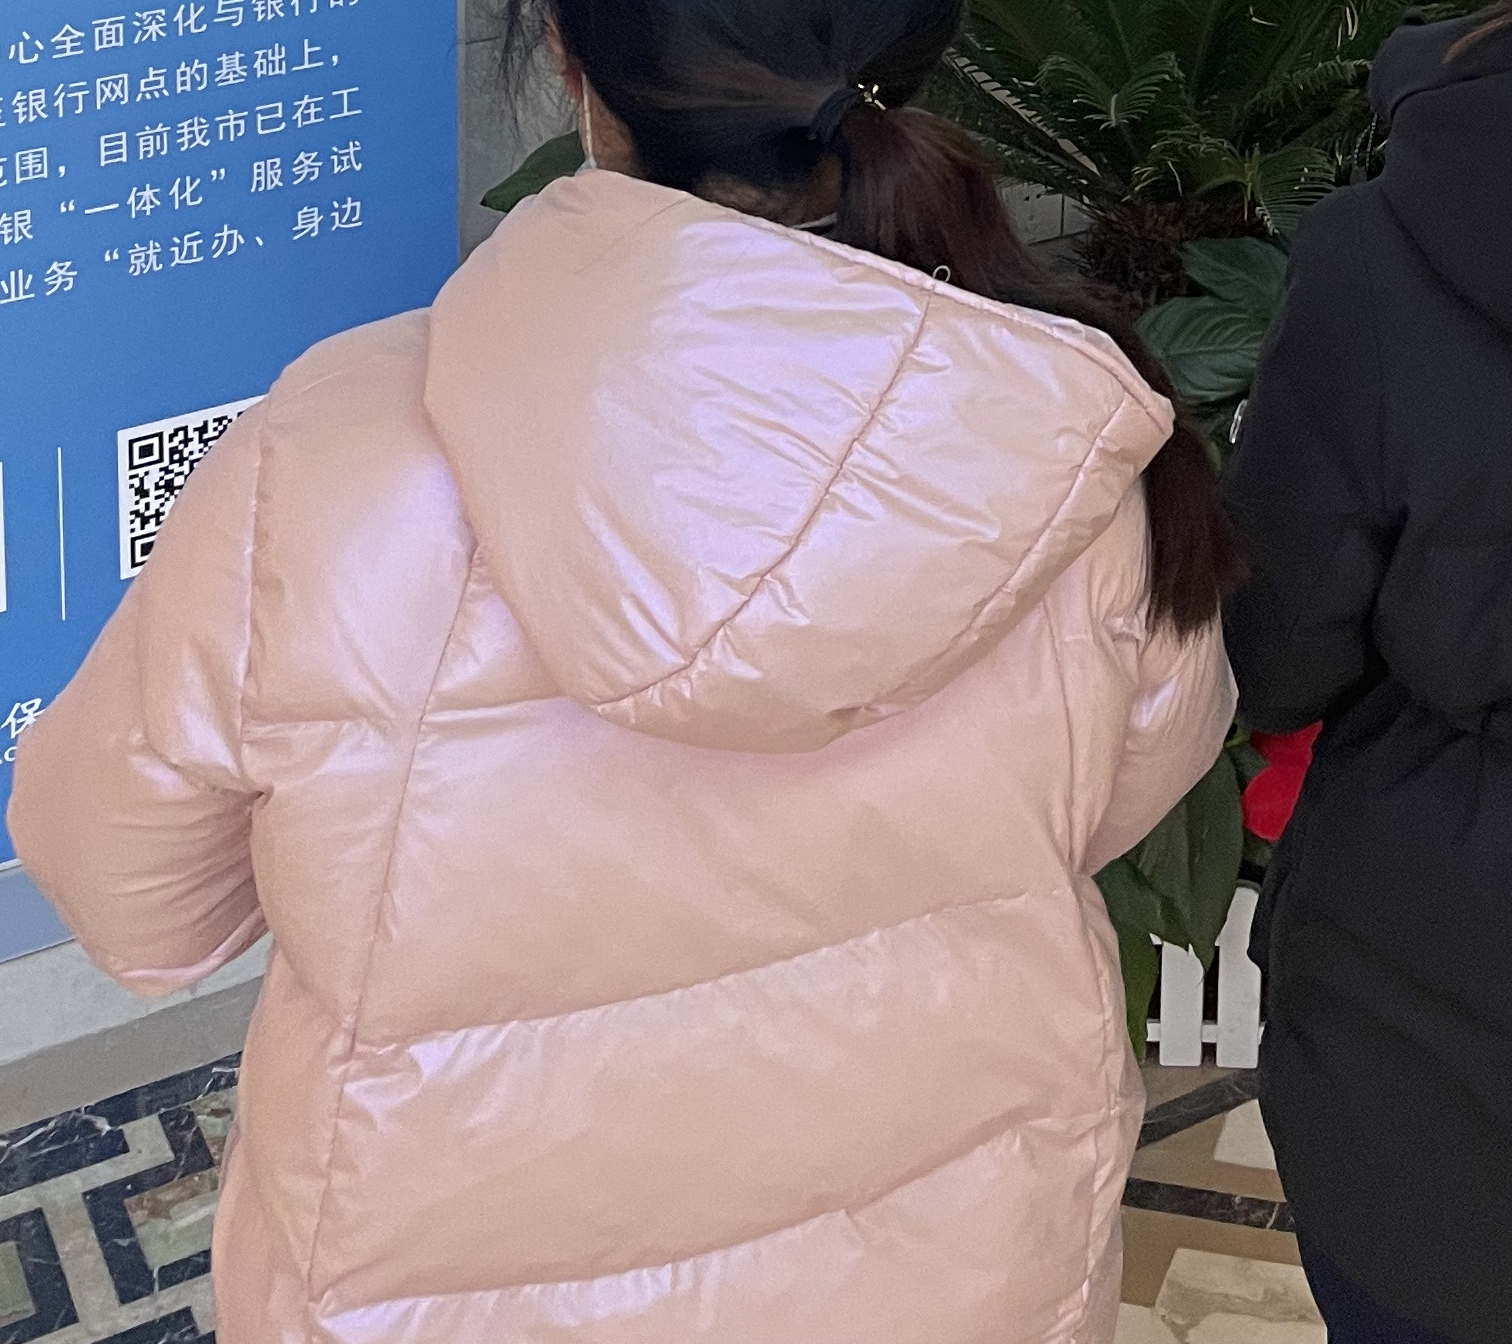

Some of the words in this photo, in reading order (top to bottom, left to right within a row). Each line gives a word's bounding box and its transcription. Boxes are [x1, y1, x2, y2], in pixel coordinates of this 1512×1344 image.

[0, 39, 341, 128] 银行网点的基础上，
